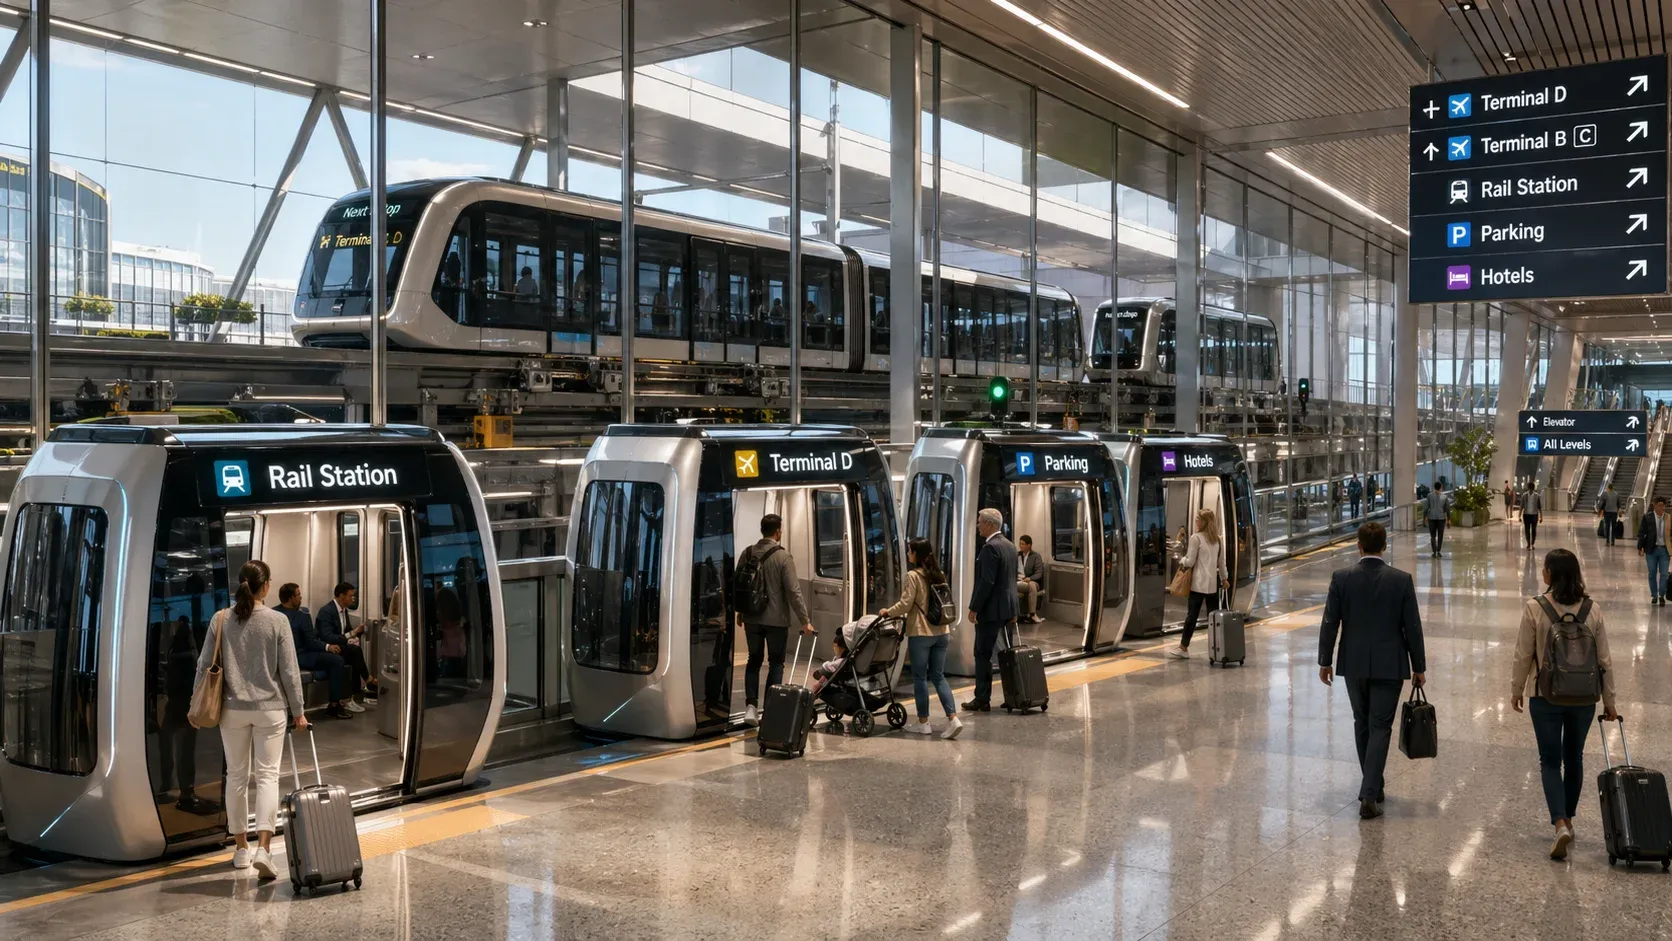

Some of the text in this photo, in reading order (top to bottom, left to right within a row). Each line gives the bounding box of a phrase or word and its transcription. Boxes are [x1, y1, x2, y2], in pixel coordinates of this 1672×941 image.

[1481, 86, 1567, 111] Terminal D
[1481, 129, 1591, 154] Terminal B C
[1481, 176, 1578, 198] Rail Station
[343, 206, 369, 218] Next
[335, 231, 403, 248] Termina D
[1452, 223, 1544, 245] P Parking
[1481, 266, 1534, 286] Hotels
[1543, 416, 1576, 427] Elevator
[1543, 439, 1592, 450] All Levels
[769, 451, 853, 473] Terminal D
[1020, 455, 1089, 474] P Parking
[1184, 453, 1214, 468] Hotels
[269, 462, 398, 490] Rail Station
